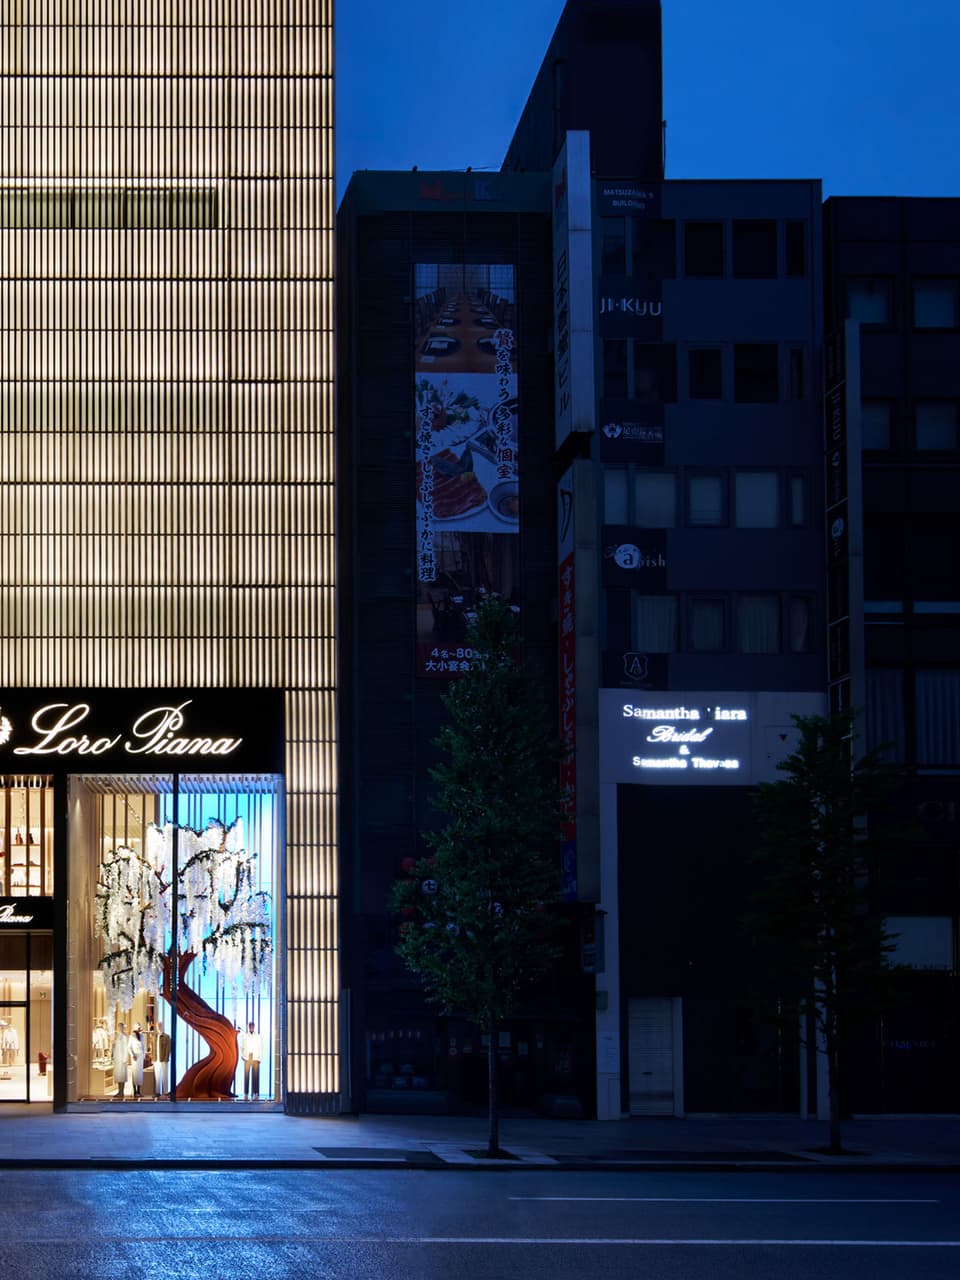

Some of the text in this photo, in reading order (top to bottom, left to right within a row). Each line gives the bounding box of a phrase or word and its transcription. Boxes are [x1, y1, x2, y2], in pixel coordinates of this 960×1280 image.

[623, 704, 748, 721] Samantha iara
[13, 700, 243, 755] Loro Piana
[646, 725, 713, 743] Bridal
[678, 744, 691, 756] &
